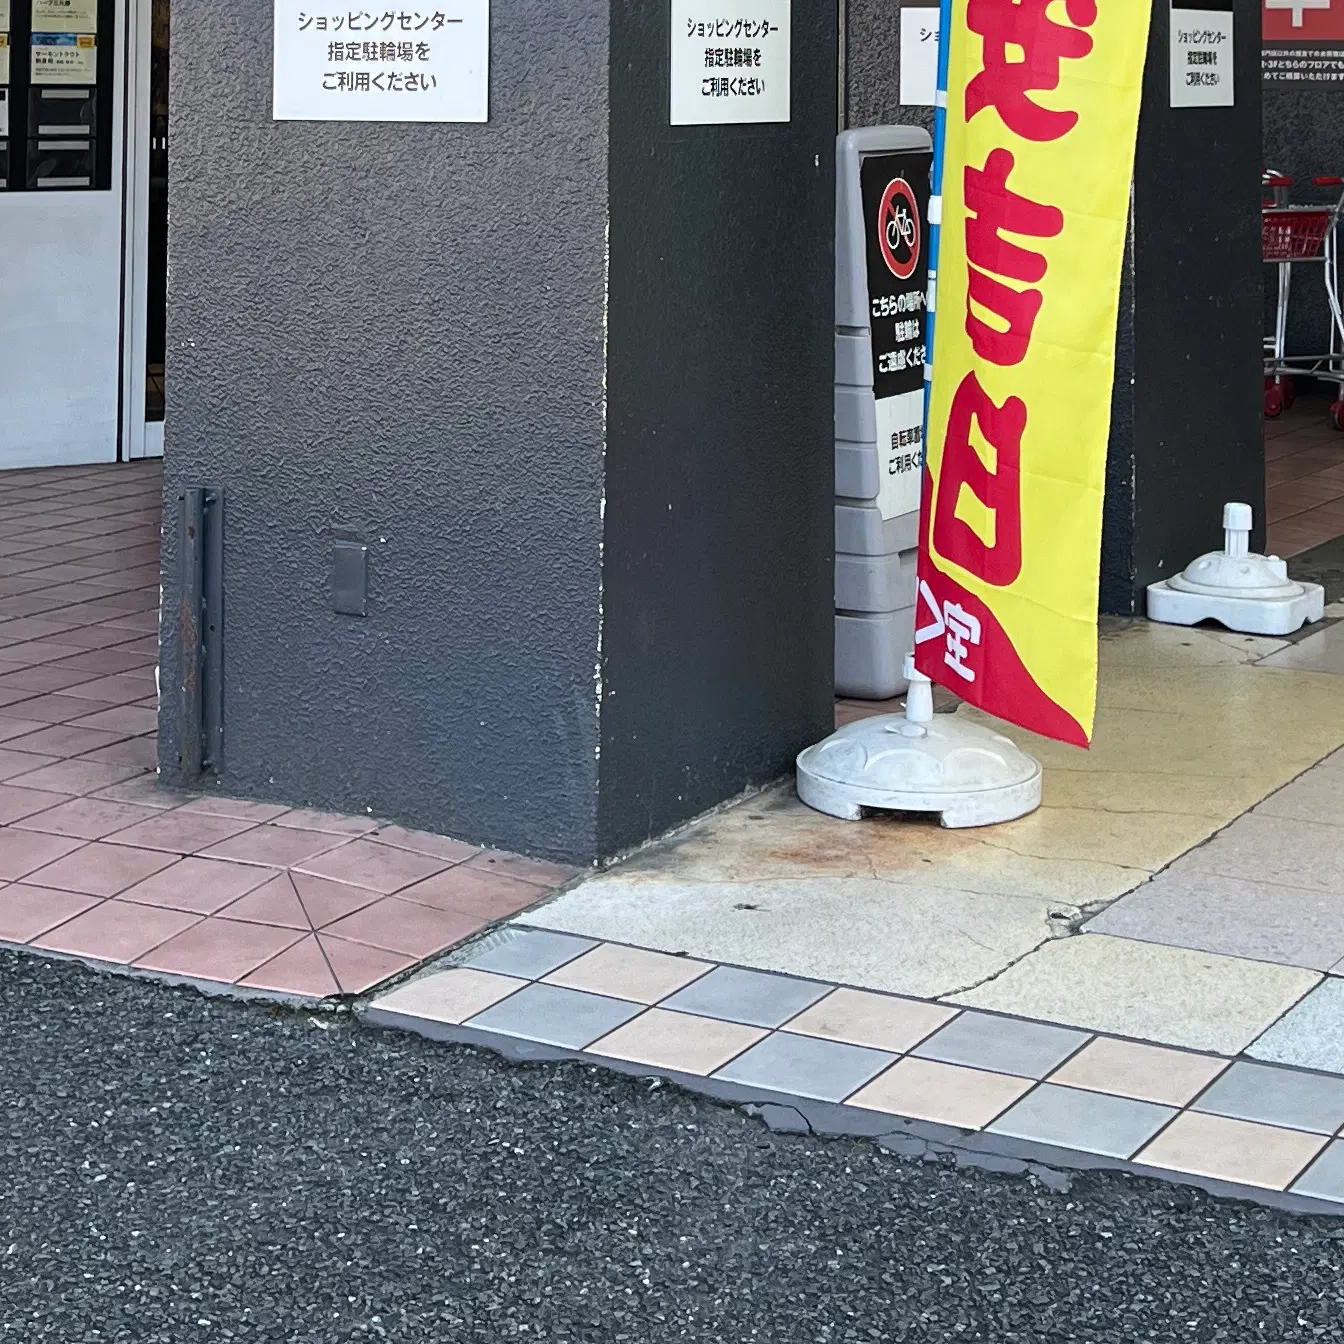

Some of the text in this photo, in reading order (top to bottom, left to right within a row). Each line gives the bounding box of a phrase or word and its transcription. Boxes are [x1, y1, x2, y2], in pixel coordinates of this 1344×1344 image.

[298, 11, 463, 31] ショッピングセンター
[687, 17, 778, 39] ショッピングセンター
[327, 41, 430, 62] 指定駐輪場を
[704, 47, 761, 68] 指定駐輪場を
[322, 71, 436, 92] ご利用ください
[701, 76, 765, 97] ご利用ください
[872, 290, 926, 317] こちらの場所へ
[878, 345, 926, 373] ご遠慮くださ
